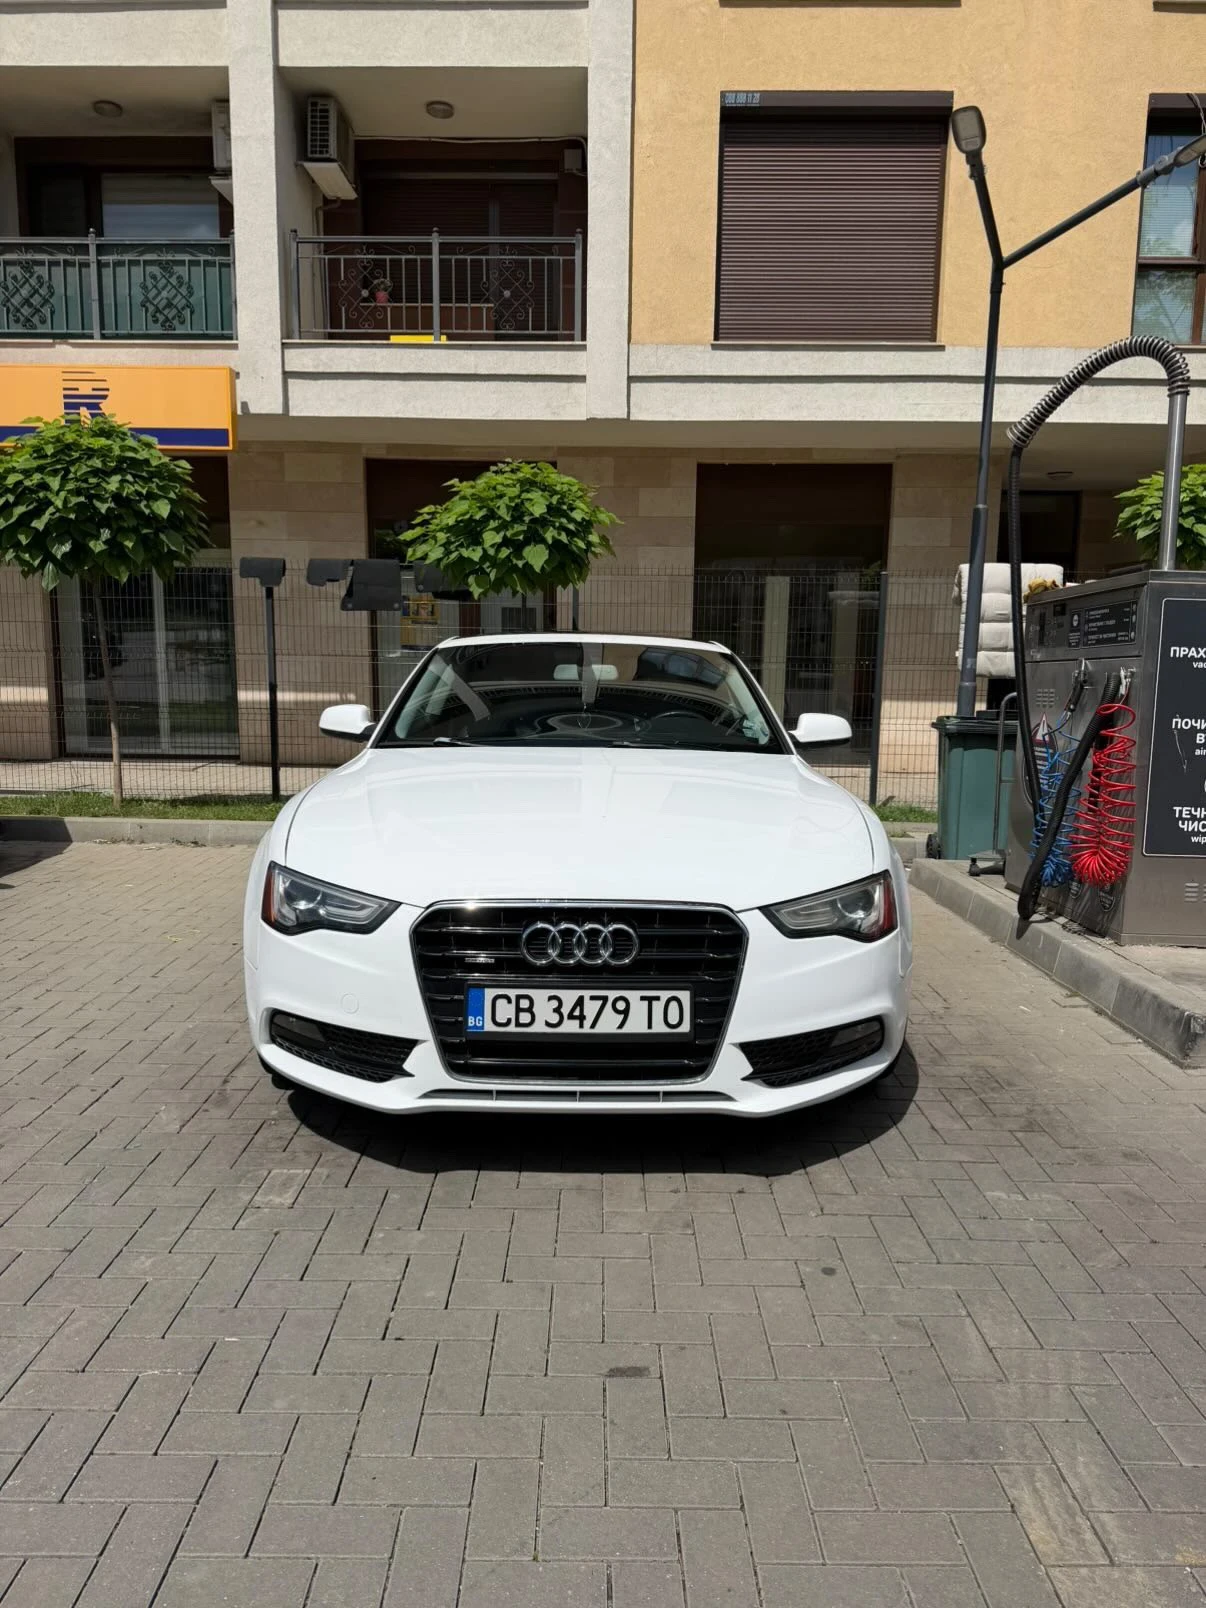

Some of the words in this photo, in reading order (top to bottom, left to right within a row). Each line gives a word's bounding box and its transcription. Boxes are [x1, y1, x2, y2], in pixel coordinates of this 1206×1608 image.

[468, 1016, 483, 1027] BG
[491, 993, 536, 1028] CB
[544, 994, 631, 1030] 3479
[640, 995, 685, 1030] TO
